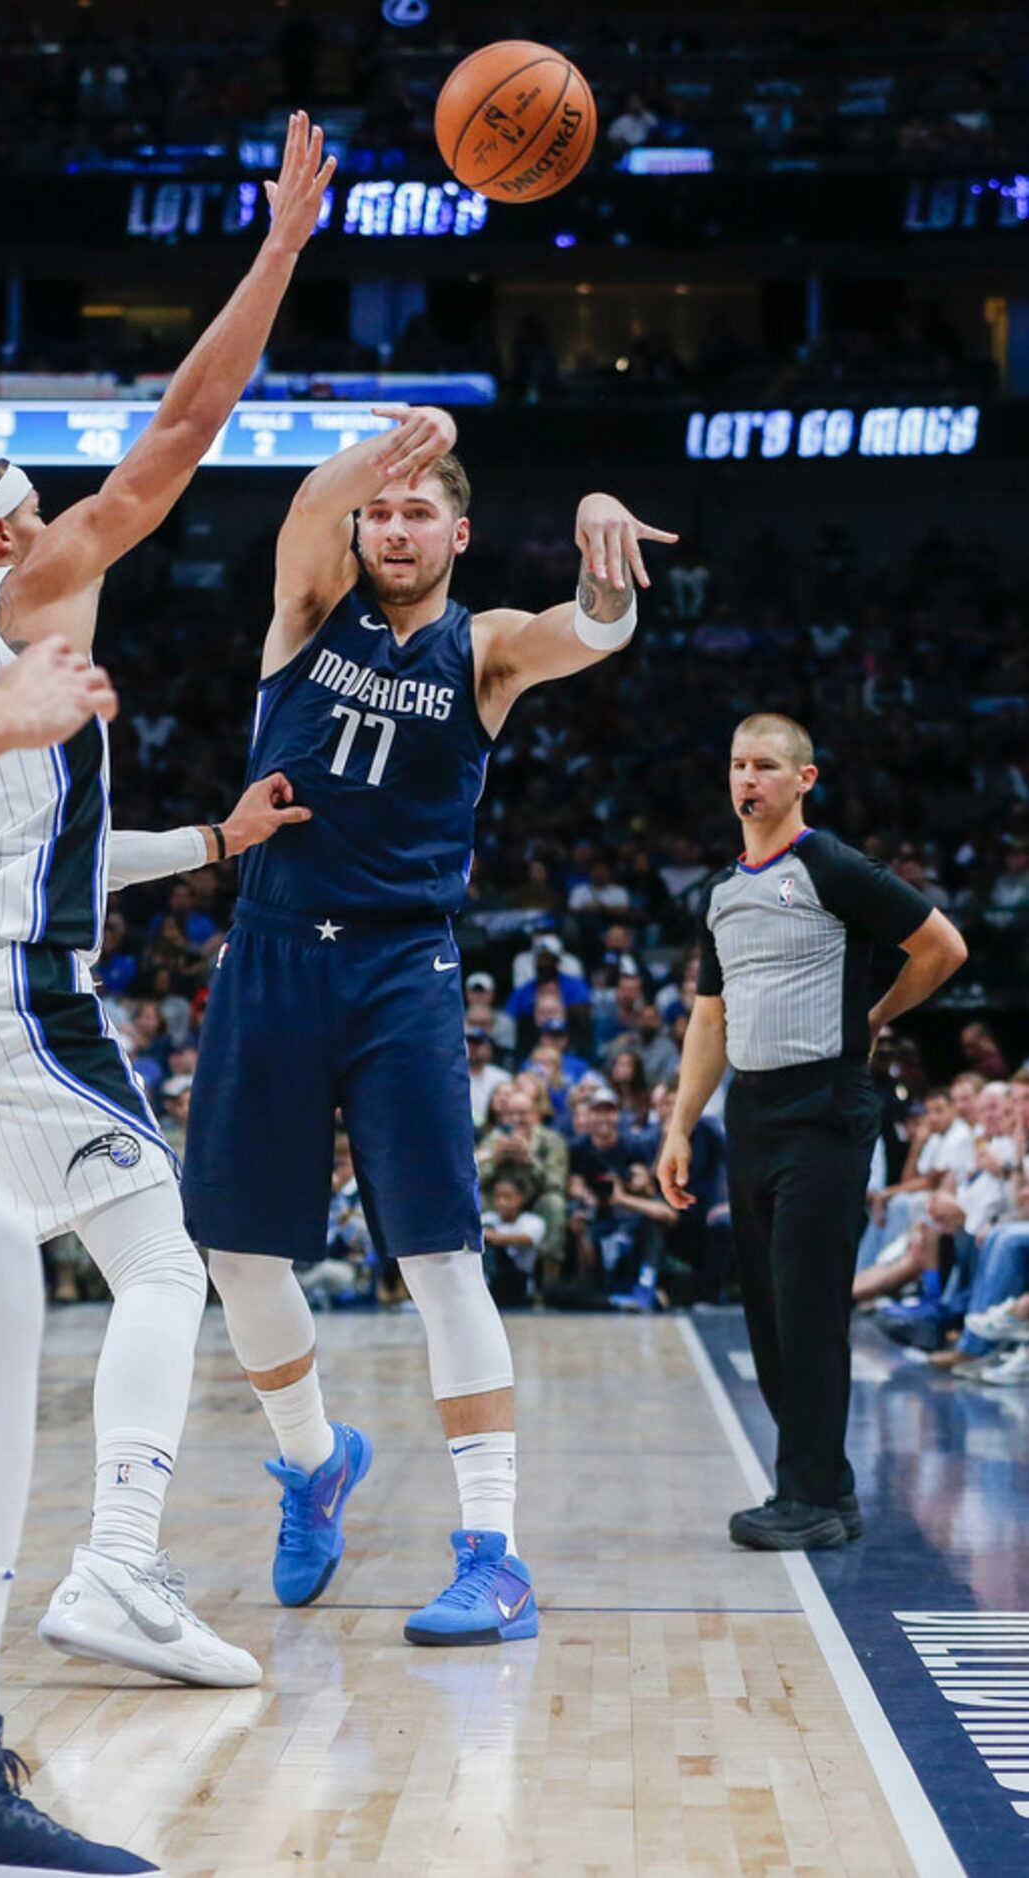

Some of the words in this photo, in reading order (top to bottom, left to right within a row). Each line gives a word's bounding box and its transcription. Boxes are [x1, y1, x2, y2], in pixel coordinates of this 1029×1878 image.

[496, 102, 583, 195] SPALDING
[308, 648, 456, 721] MAVERICKS
[330, 703, 397, 787] 77
